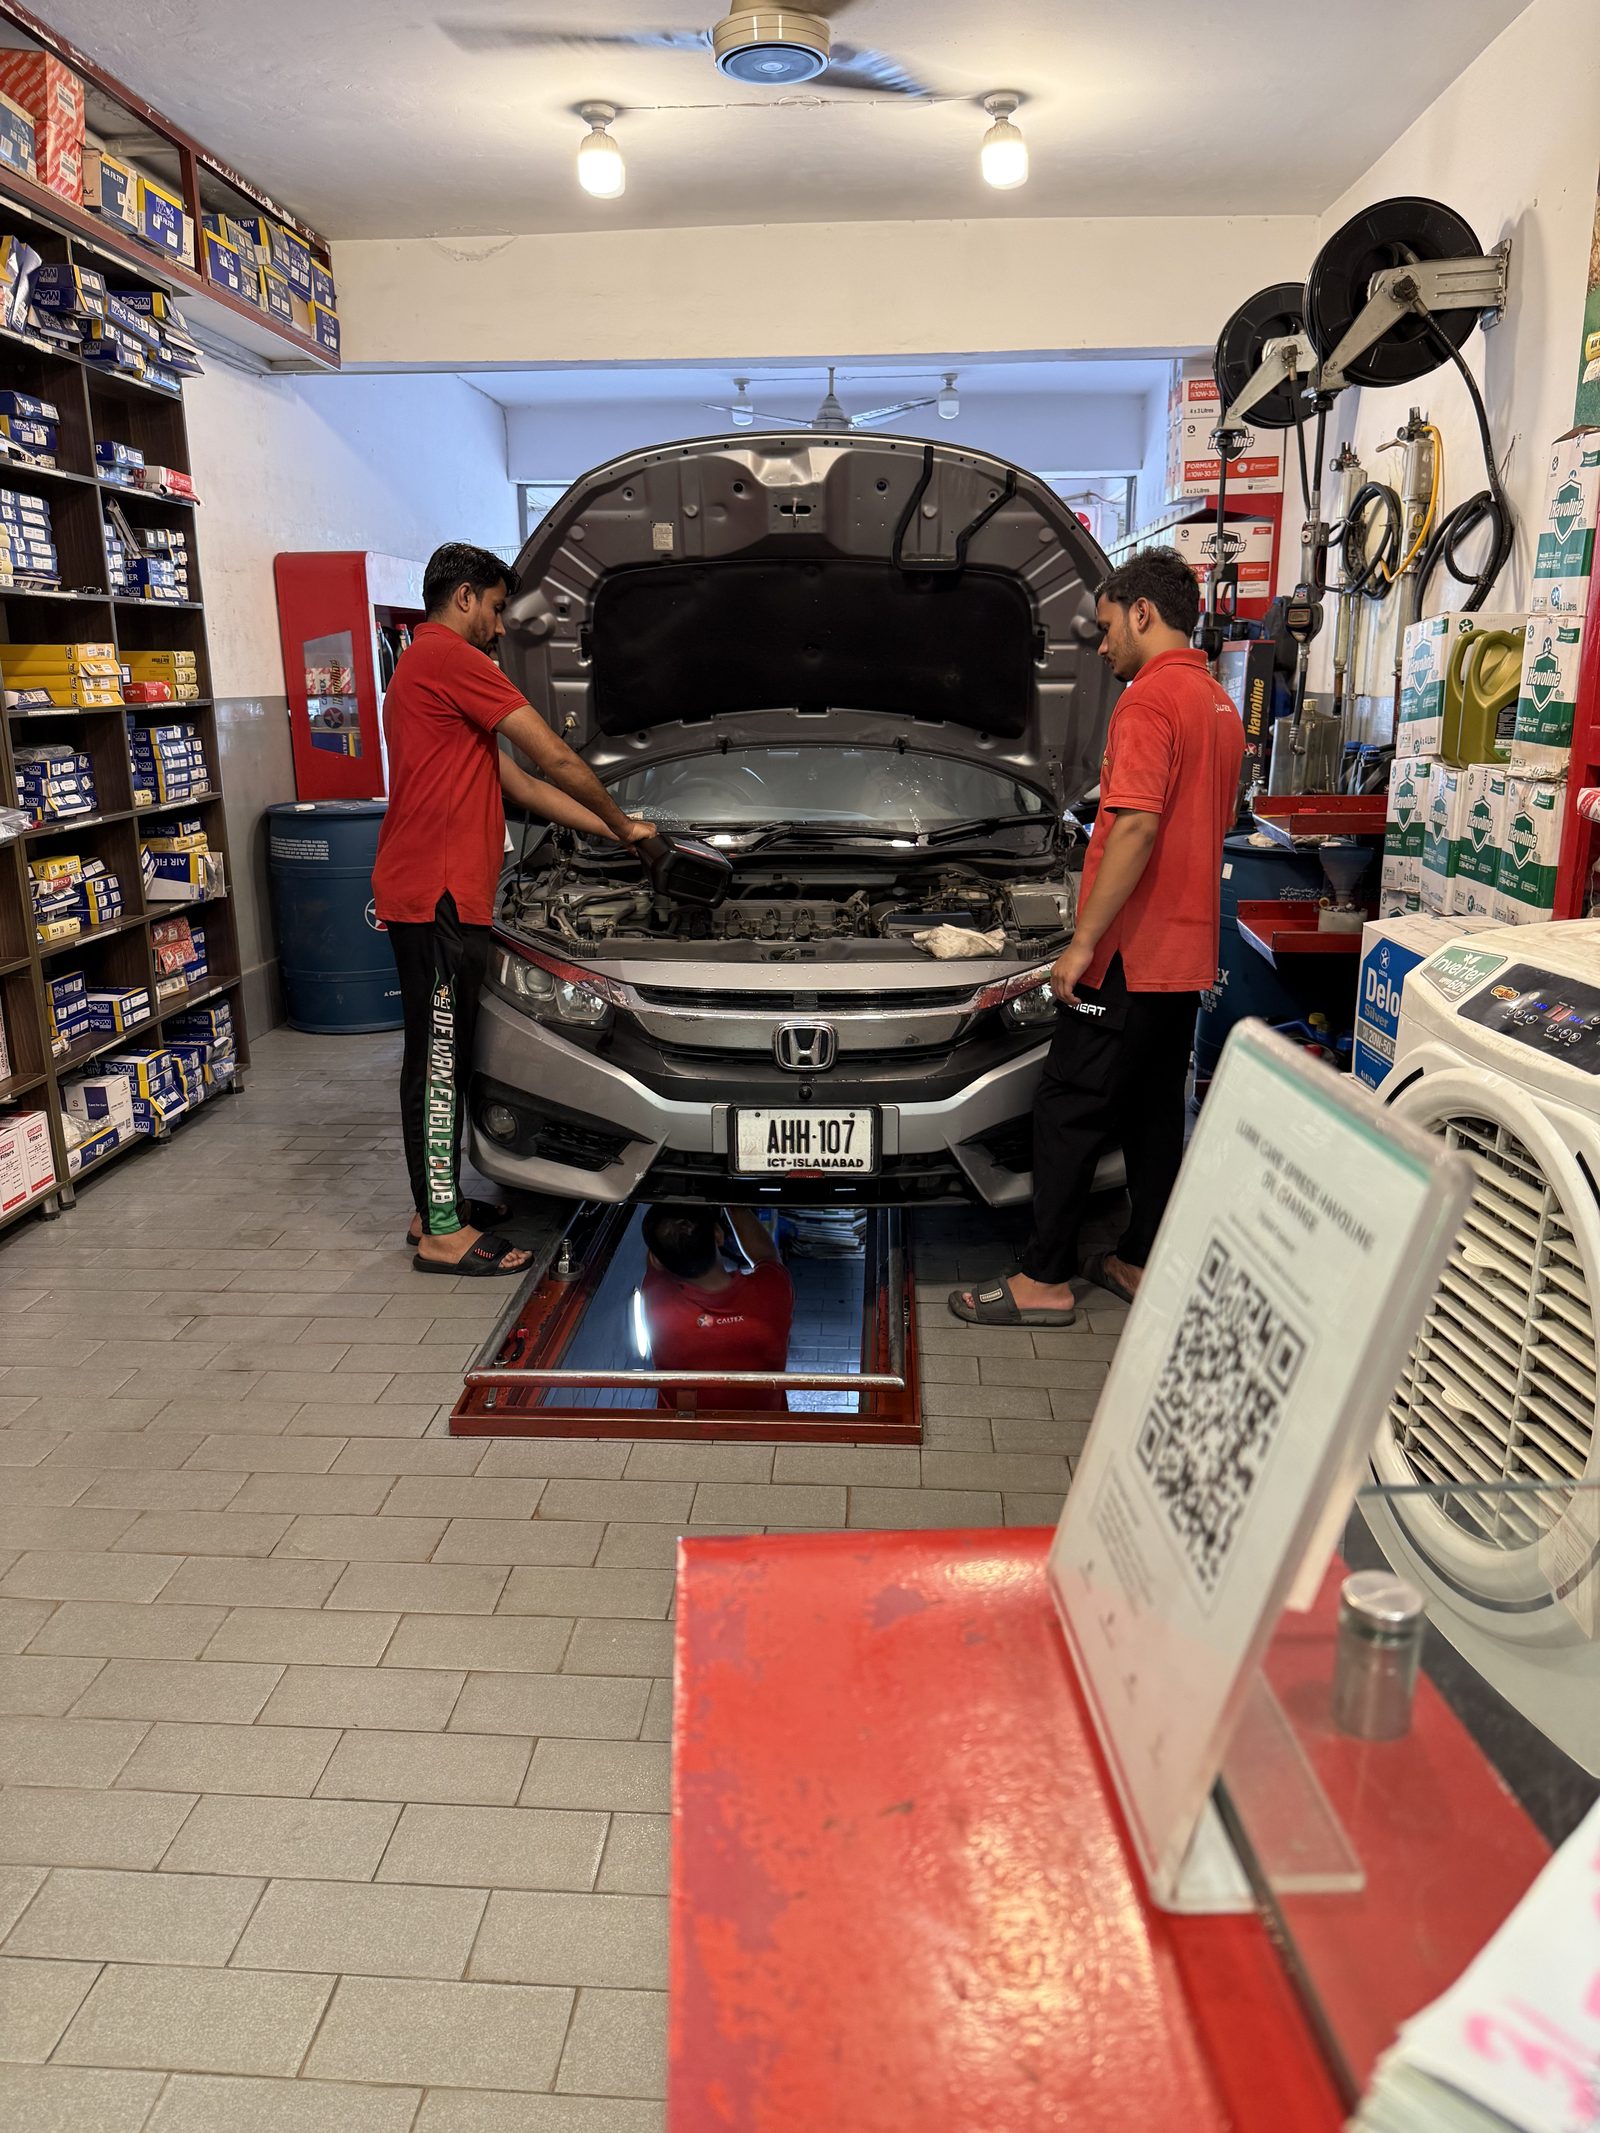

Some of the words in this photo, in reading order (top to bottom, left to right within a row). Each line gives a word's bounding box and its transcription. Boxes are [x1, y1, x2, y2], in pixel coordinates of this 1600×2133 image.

[102, 166, 110, 176] AIR
[110, 170, 124, 185] FILTER
[1190, 381, 1216, 390] FORMUL
[1208, 436, 1255, 450] Hline
[1550, 498, 1584, 520] Havoline
[1200, 540, 1247, 554] Haline
[1566, 602, 1577, 610] Litres
[330, 658, 344, 706] Havoline
[1526, 667, 1562, 688] Havoline
[320, 678, 328, 706] CALTEX
[1248, 678, 1264, 736] Havoline
[1467, 810, 1493, 833] Havoline
[1508, 823, 1538, 850] Havoline
[156, 858, 168, 866] FIL
[170, 858, 186, 866] AIR
[1431, 956, 1486, 982] Inverter
[433, 994, 451, 1010] DEC
[1365, 967, 1400, 1018] Delo
[1364, 1003, 1389, 1028] Silver
[430, 1010, 454, 1085] DEWAN
[1368, 1030, 1392, 1056] 20W-50
[428, 1086, 452, 1150] EAGLE
[30, 1134, 42, 1143] Filters
[0, 1150, 15, 1160] Filters
[768, 1158, 864, 1168] ICT-ISLAMABAD
[428, 1155, 454, 1204] CLUB
[1276, 1184, 1319, 1234] CHANGE
[1317, 1192, 1375, 1252] HAVOLINE
[716, 1316, 744, 1325] CALTEX
